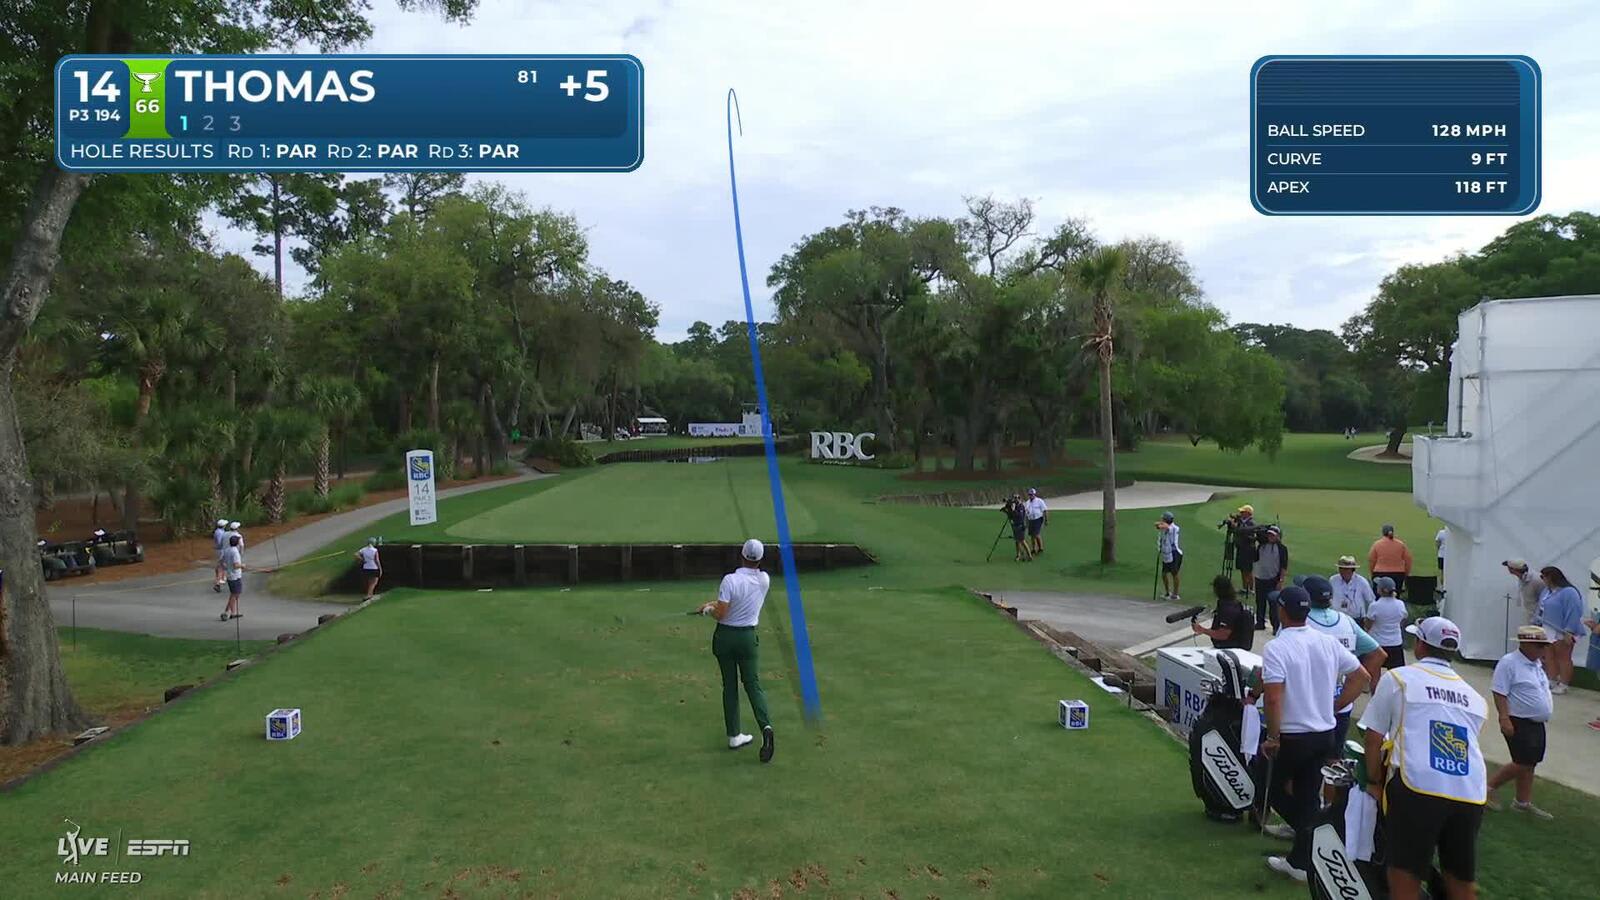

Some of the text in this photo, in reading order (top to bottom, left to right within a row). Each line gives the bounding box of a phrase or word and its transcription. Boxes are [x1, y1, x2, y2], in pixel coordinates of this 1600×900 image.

[810, 431, 876, 460] RBC
[414, 483, 430, 496] 14
[1426, 686, 1470, 708] THOMAS
[1205, 746, 1250, 801] Titleist
[1435, 756, 1467, 775] RBC
